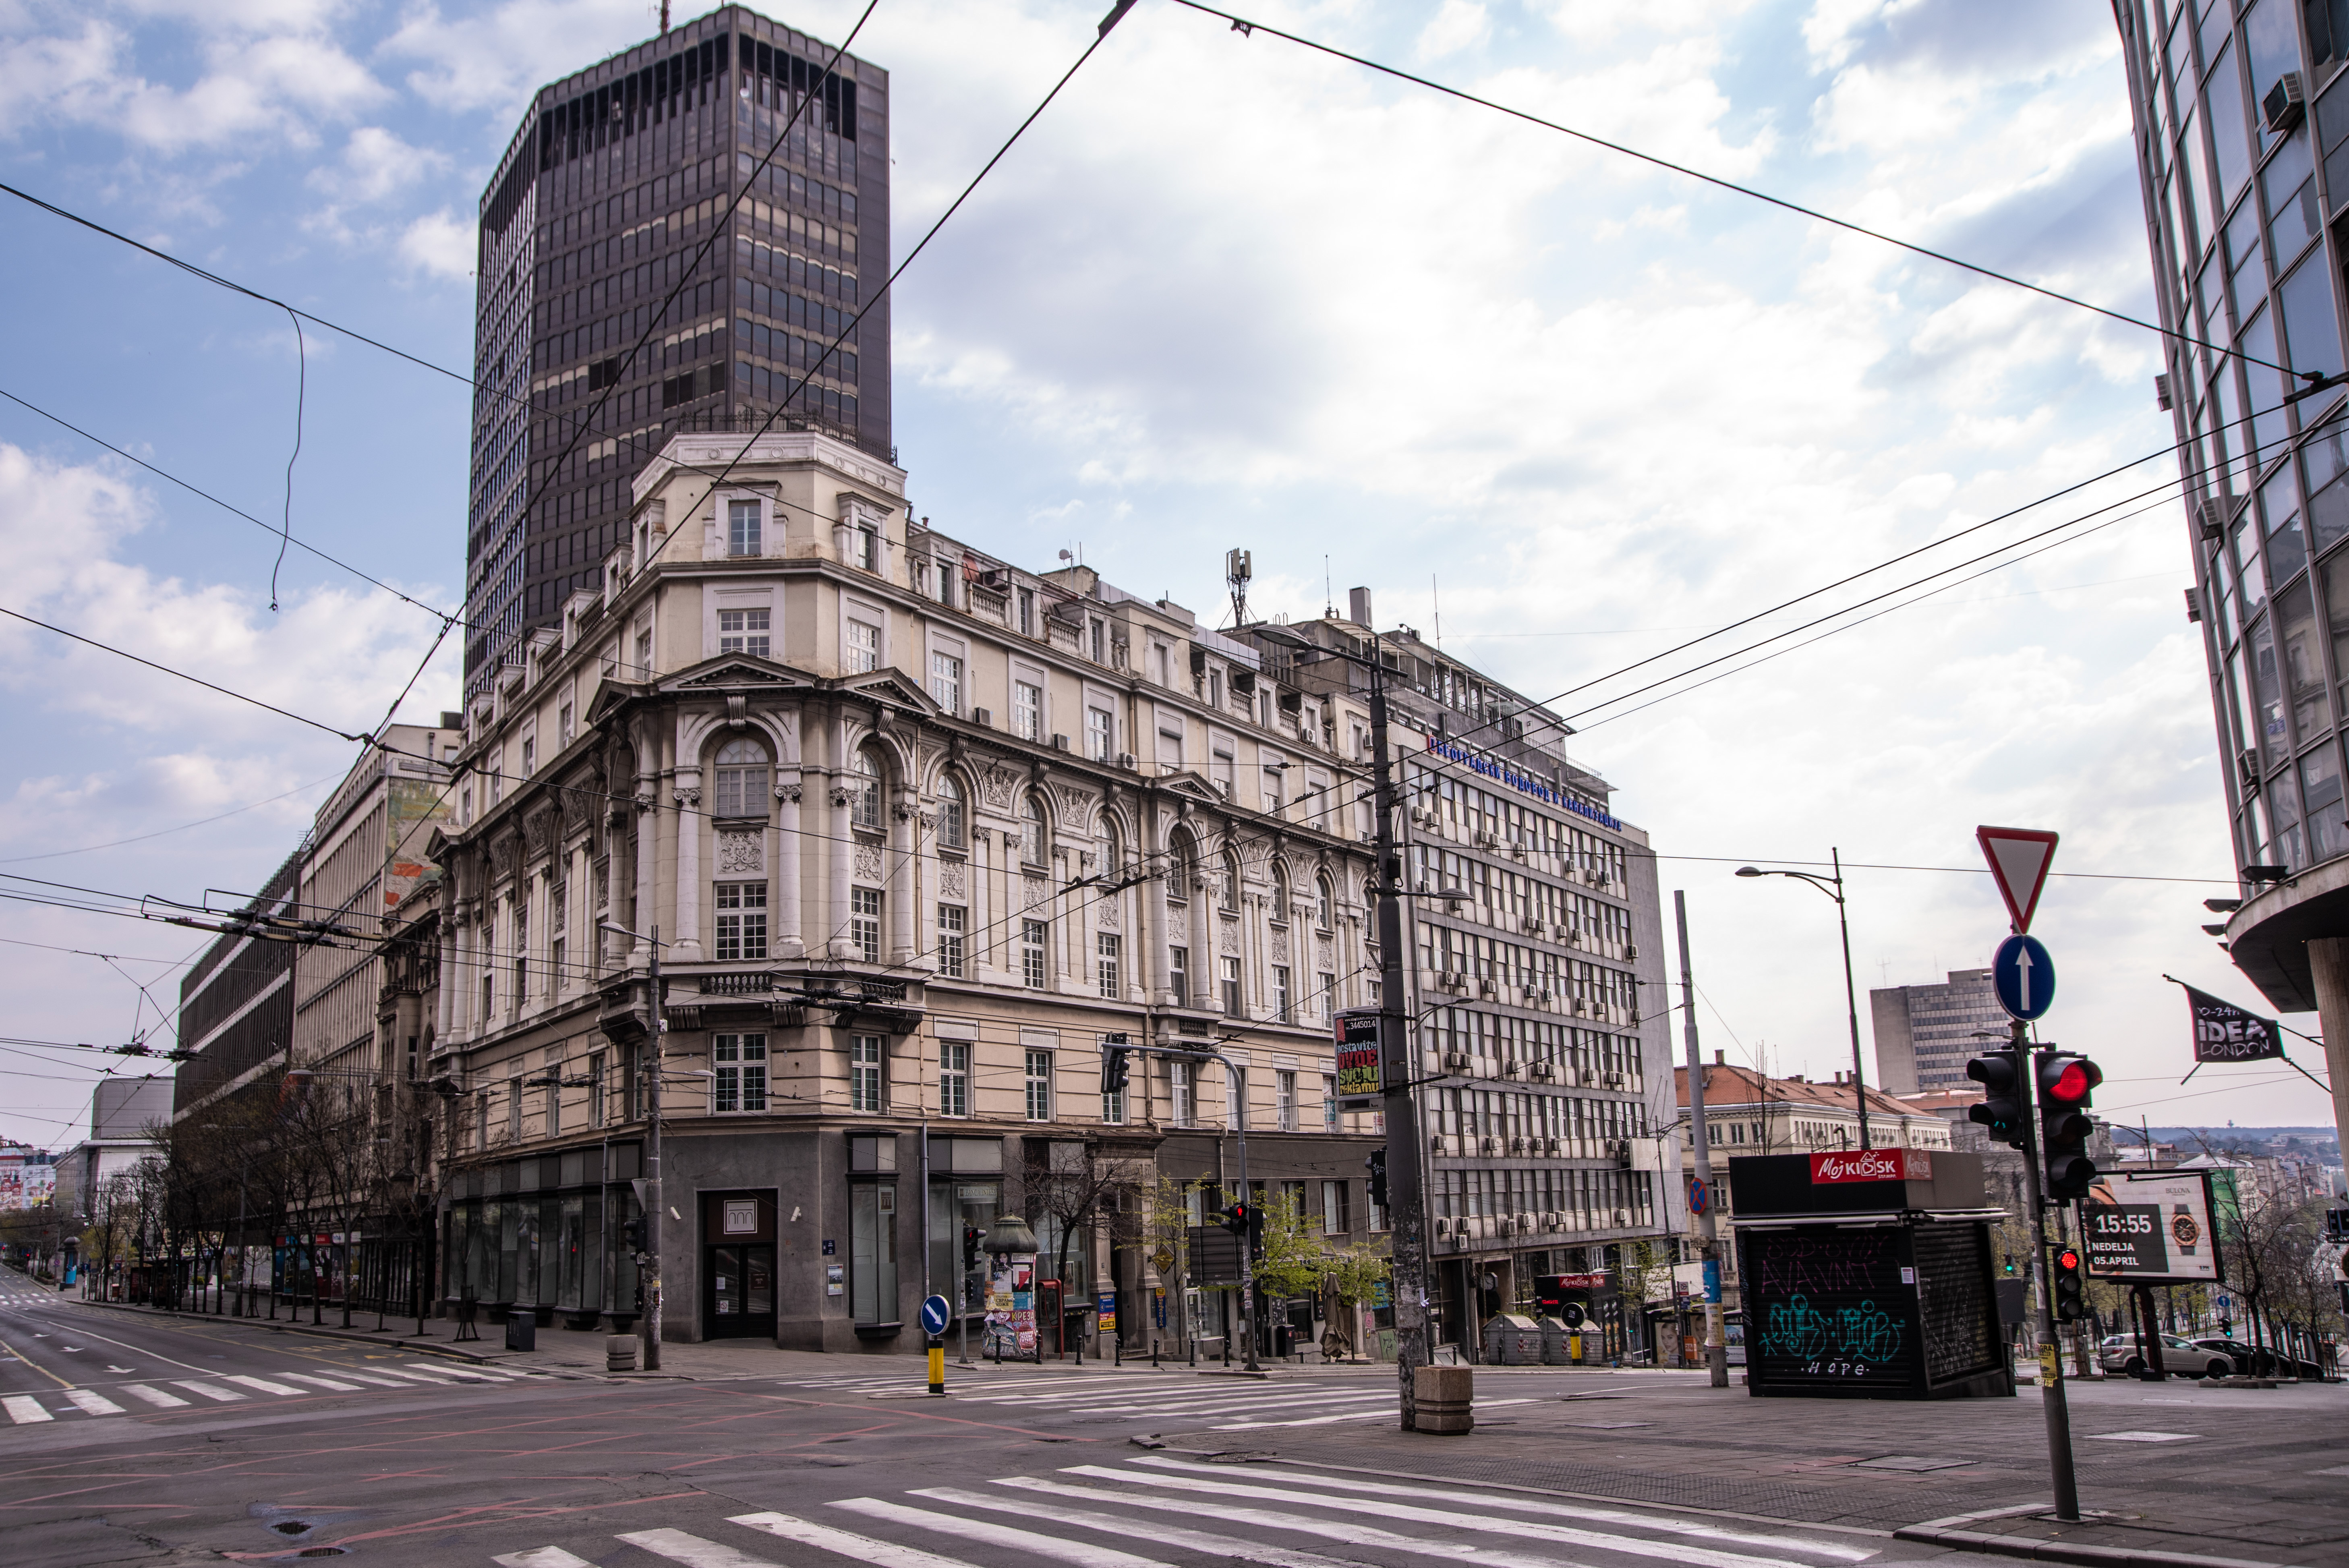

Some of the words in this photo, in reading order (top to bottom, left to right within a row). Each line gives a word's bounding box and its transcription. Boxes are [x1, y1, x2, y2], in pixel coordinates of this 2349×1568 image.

[1437, 740, 1500, 779] БЕОГРАДСКИ
[1504, 770, 1550, 802] ВОДОВОД
[1553, 791, 1559, 804] И
[1562, 796, 1622, 832] КАНАЛИЗАЦИЈА
[1350, 1020, 1376, 1029] 3445014
[1337, 1040, 1377, 1056] postavite
[2200, 1038, 2270, 1056] LONDON
[1338, 1049, 1378, 1069] OVDE
[1340, 1082, 1379, 1095] reklamu
[2096, 1214, 2152, 1233] 15:55
[2092, 1243, 2135, 1251] NEDELJA
[2094, 1256, 2140, 1266] 05.APRIL
